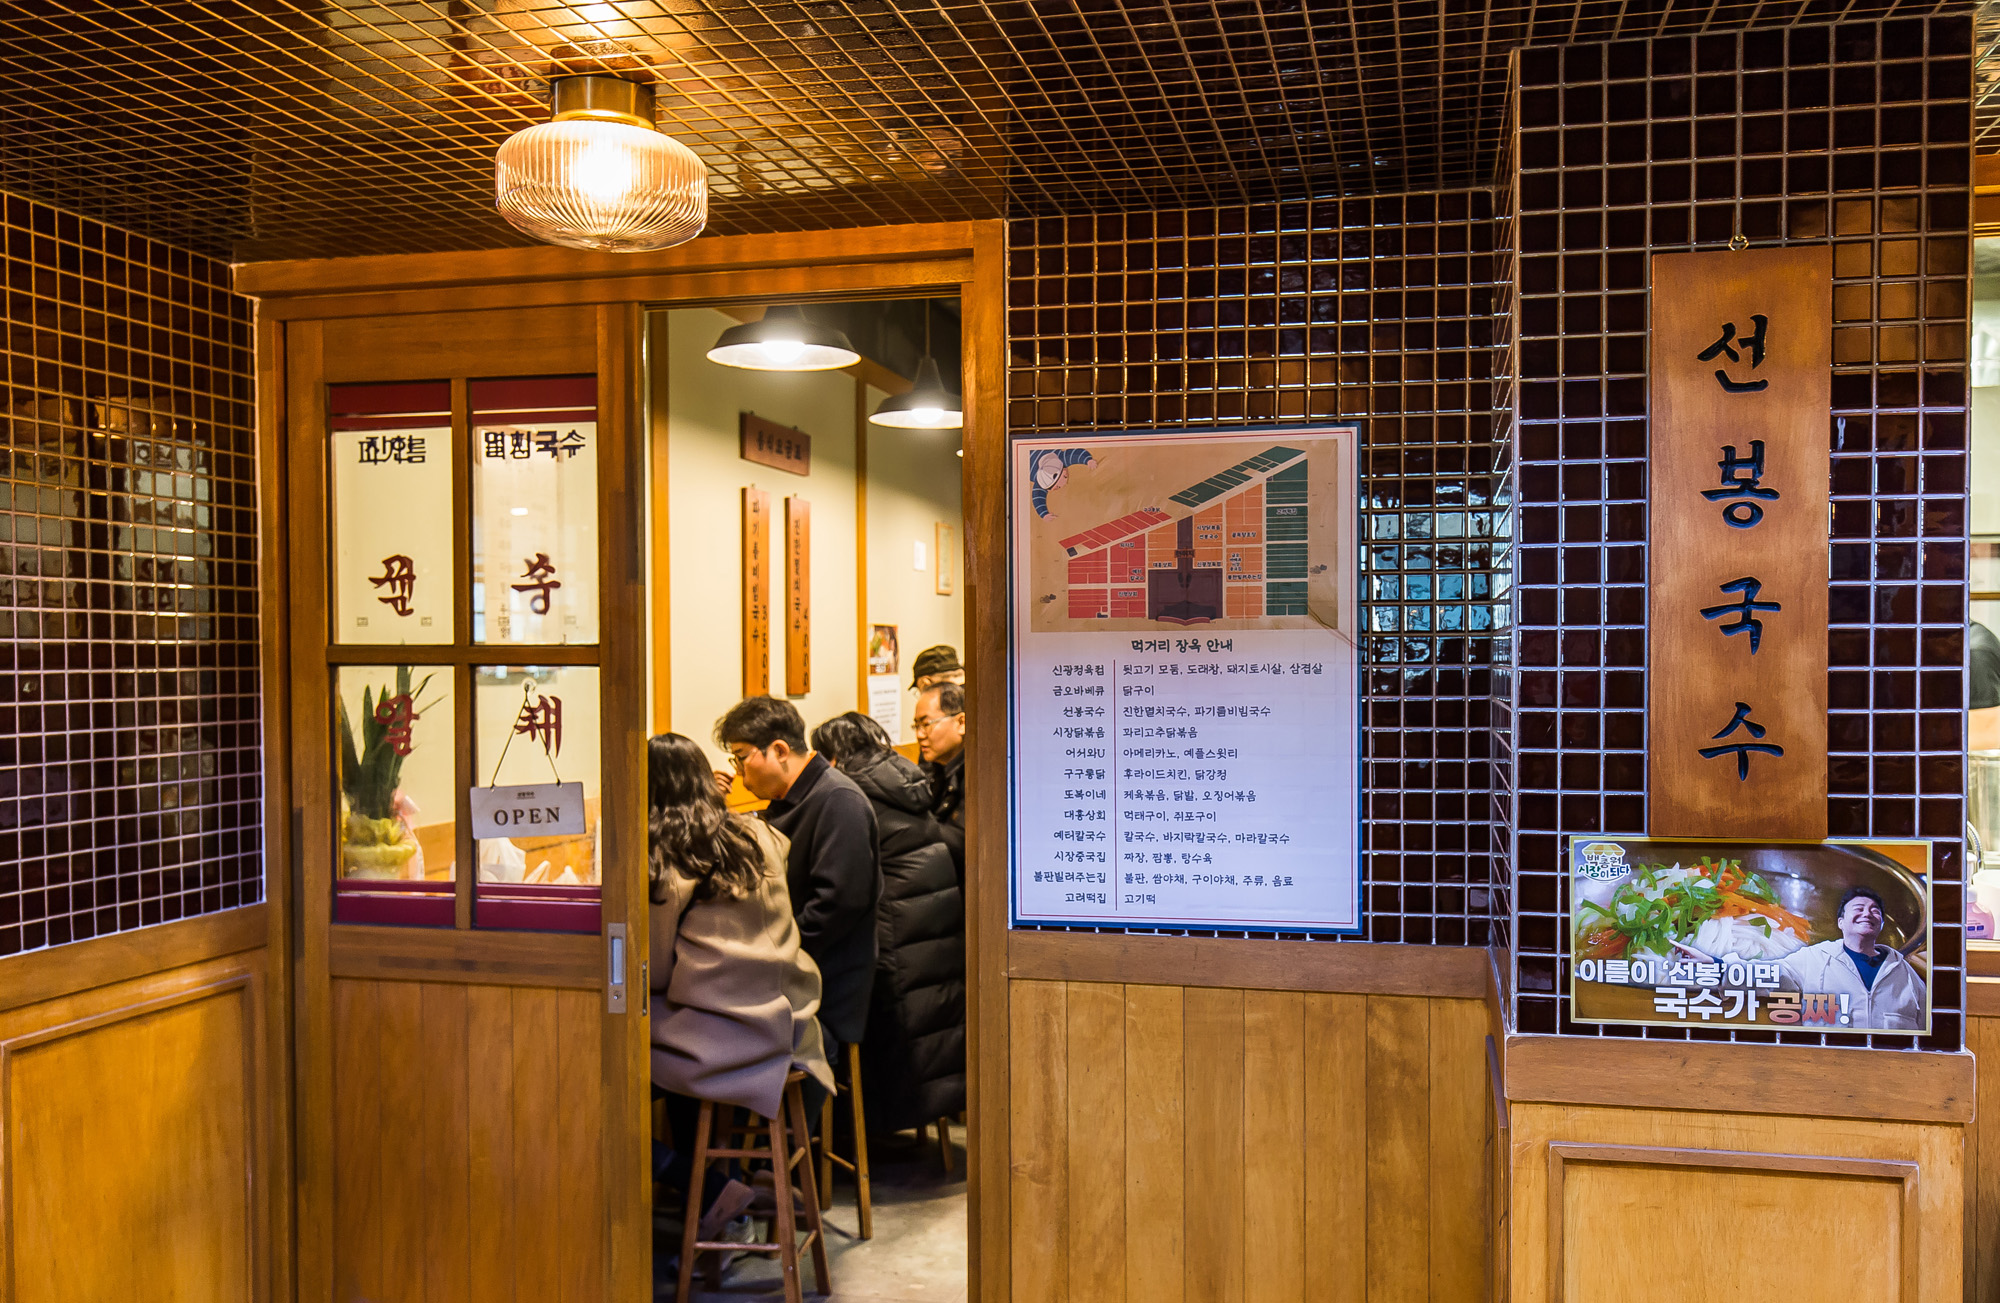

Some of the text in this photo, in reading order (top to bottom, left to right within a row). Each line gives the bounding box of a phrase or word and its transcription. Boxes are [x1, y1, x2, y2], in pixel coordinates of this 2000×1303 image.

[1697, 314, 1785, 781] 선봉국수
[1131, 639, 1233, 654] 먹거리 장옥 안내
[1052, 664, 1104, 676] 신광정육점
[1122, 662, 1323, 676] 뒷고기 모둠, 도래창, 돼지토시살, 삼겹살
[1053, 685, 1104, 696] 금오바베큐
[1122, 685, 1154, 696] 닭구이
[1063, 706, 1105, 717] 선봉국수
[1122, 706, 1271, 717] 진한멸치국수, 파기름비빔국수
[1053, 726, 1105, 738] 시장닭볶음
[1122, 726, 1198, 738] 꽈리고추닭볶음
[1065, 747, 1105, 758] 어서와U
[1123, 747, 1180, 759] 아메리카노,
[1064, 768, 1105, 780] 구구통닭
[1123, 768, 1227, 781] 후라이드치킨, 닭강정
[1064, 789, 1106, 800] 또복이네
[1123, 789, 1256, 802] 제육볶음, 닭발, 오징어볶음
[494, 807, 560, 826] OPEN
[1064, 809, 1106, 821] 대흥상회
[1123, 810, 1217, 822] 먹태구이, 쥐포구이
[1053, 830, 1106, 841] 예터칼국수
[1123, 831, 1290, 845] 칼국수, 바지락칼국수, 마라칼국수
[1054, 850, 1105, 862] 시장중국집
[1123, 852, 1213, 864] 짜장, 짬뽕, 탕수육
[1587, 854, 1621, 868] 백종원
[1033, 870, 1106, 883] 불판빌려주는집
[1123, 872, 1294, 887] 불판, 쌈야채, 구이야채, 주류, 음료
[1065, 892, 1106, 904] 고려떡집
[1124, 893, 1156, 905] 고기떡
[1579, 959, 1655, 985] 이름이
[1653, 986, 1851, 1025] 국수가 공짜!
